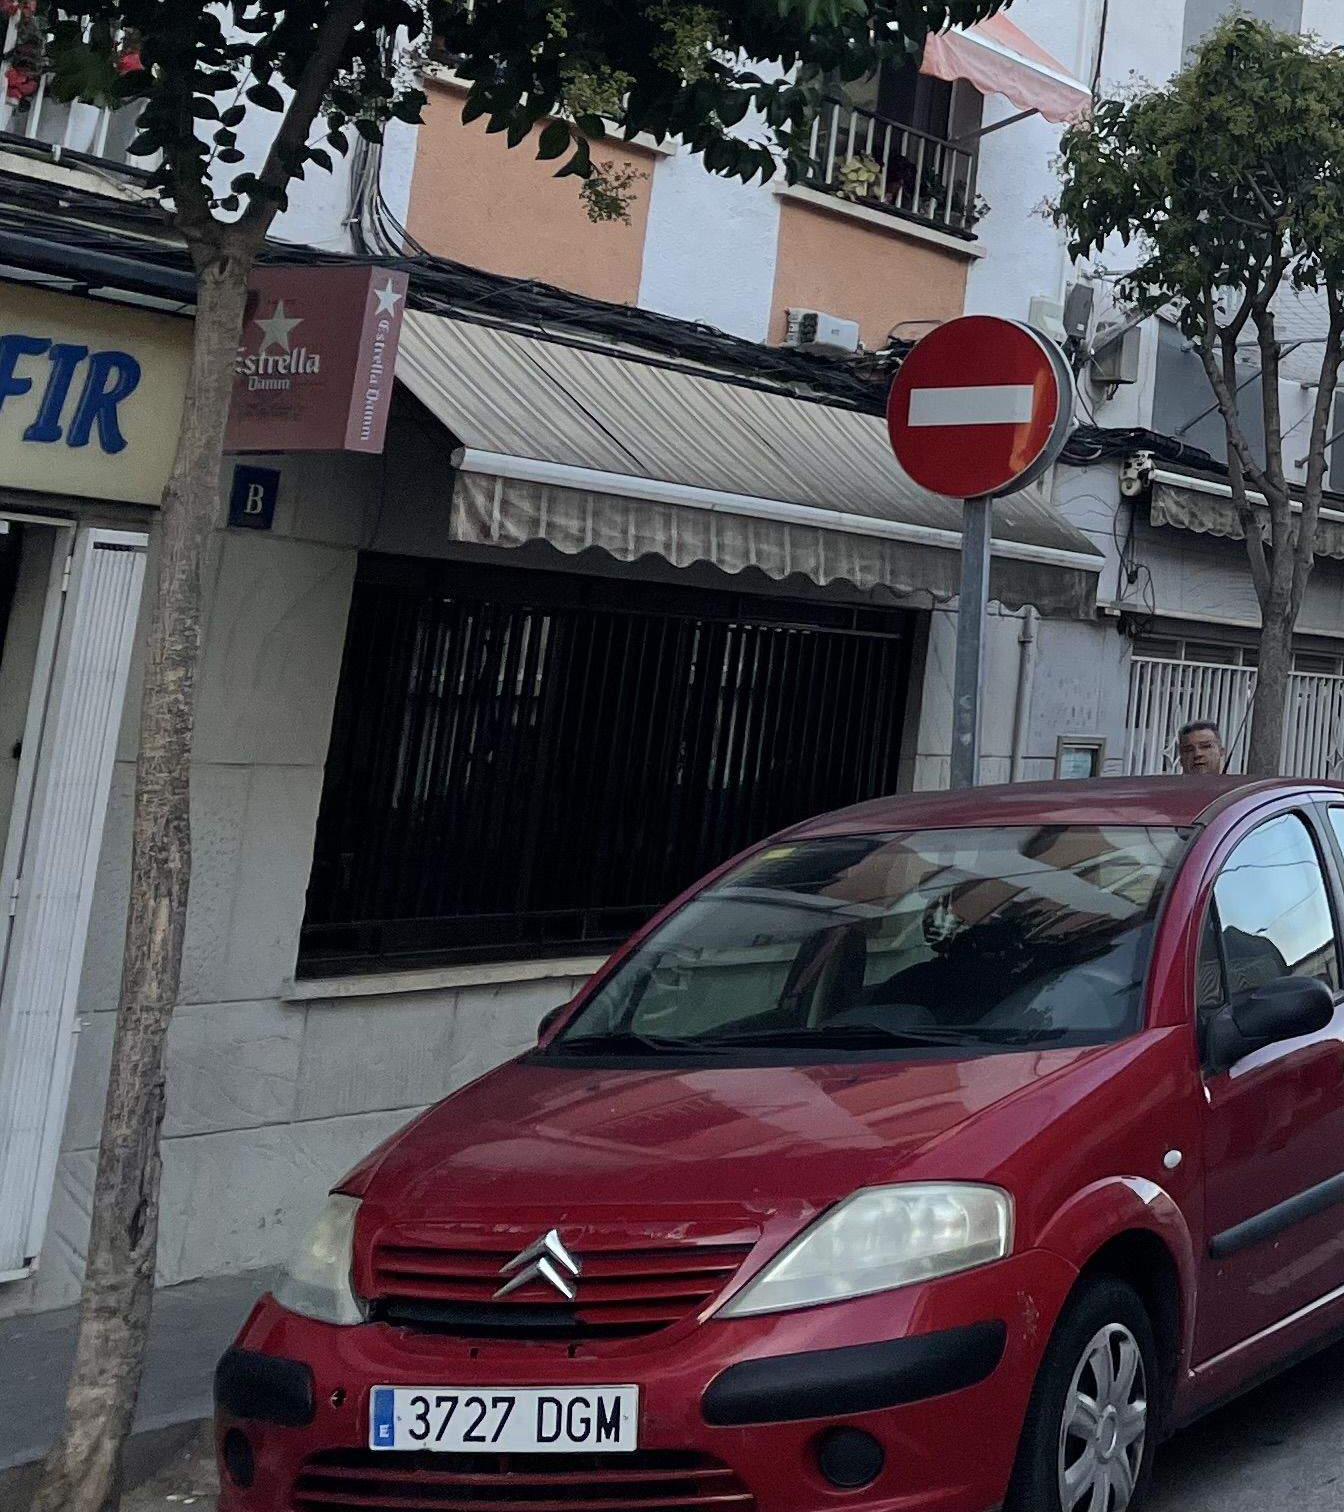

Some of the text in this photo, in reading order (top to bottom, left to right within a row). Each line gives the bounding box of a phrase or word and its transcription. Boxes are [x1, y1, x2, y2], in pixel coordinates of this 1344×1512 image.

[243, 483, 265, 514] B
[408, 1394, 622, 1443] 3727 DGM
